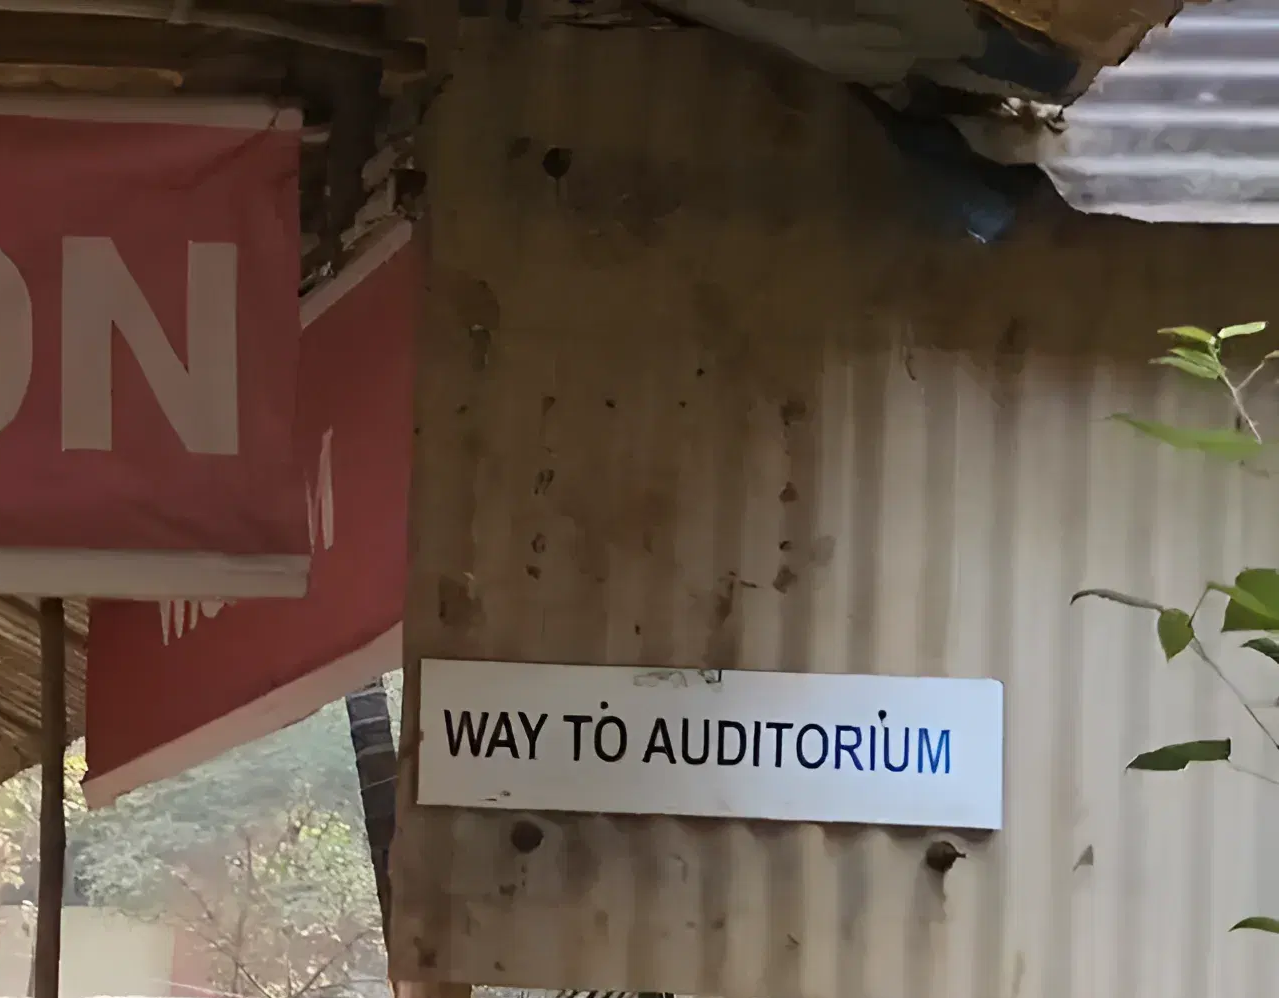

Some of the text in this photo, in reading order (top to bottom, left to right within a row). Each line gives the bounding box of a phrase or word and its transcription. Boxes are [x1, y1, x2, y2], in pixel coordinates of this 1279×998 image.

[443, 709, 950, 774] WAY TO AUDITORIUM
